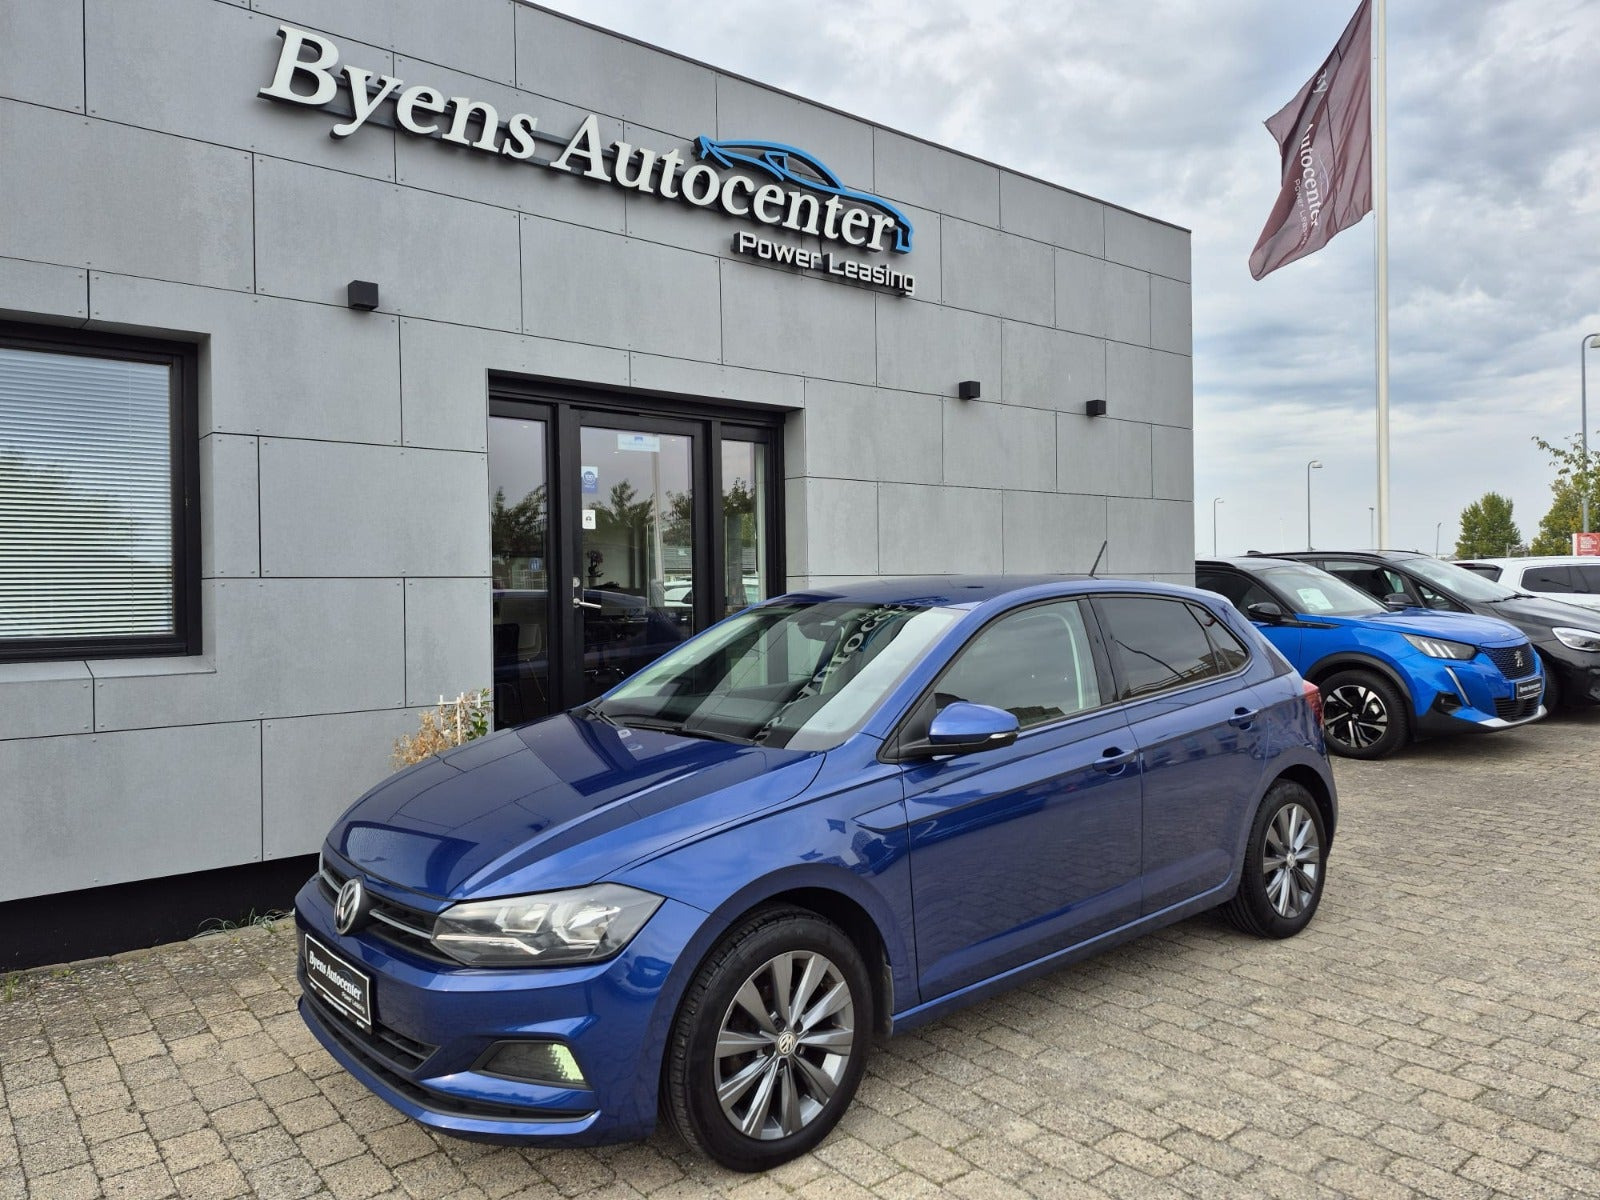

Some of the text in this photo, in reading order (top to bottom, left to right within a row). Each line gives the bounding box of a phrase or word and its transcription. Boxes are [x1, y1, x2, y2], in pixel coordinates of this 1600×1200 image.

[258, 24, 895, 251] Byens Autocenter
[738, 230, 916, 296] Power Leasing
[309, 950, 362, 1000] Byens Autocenter
